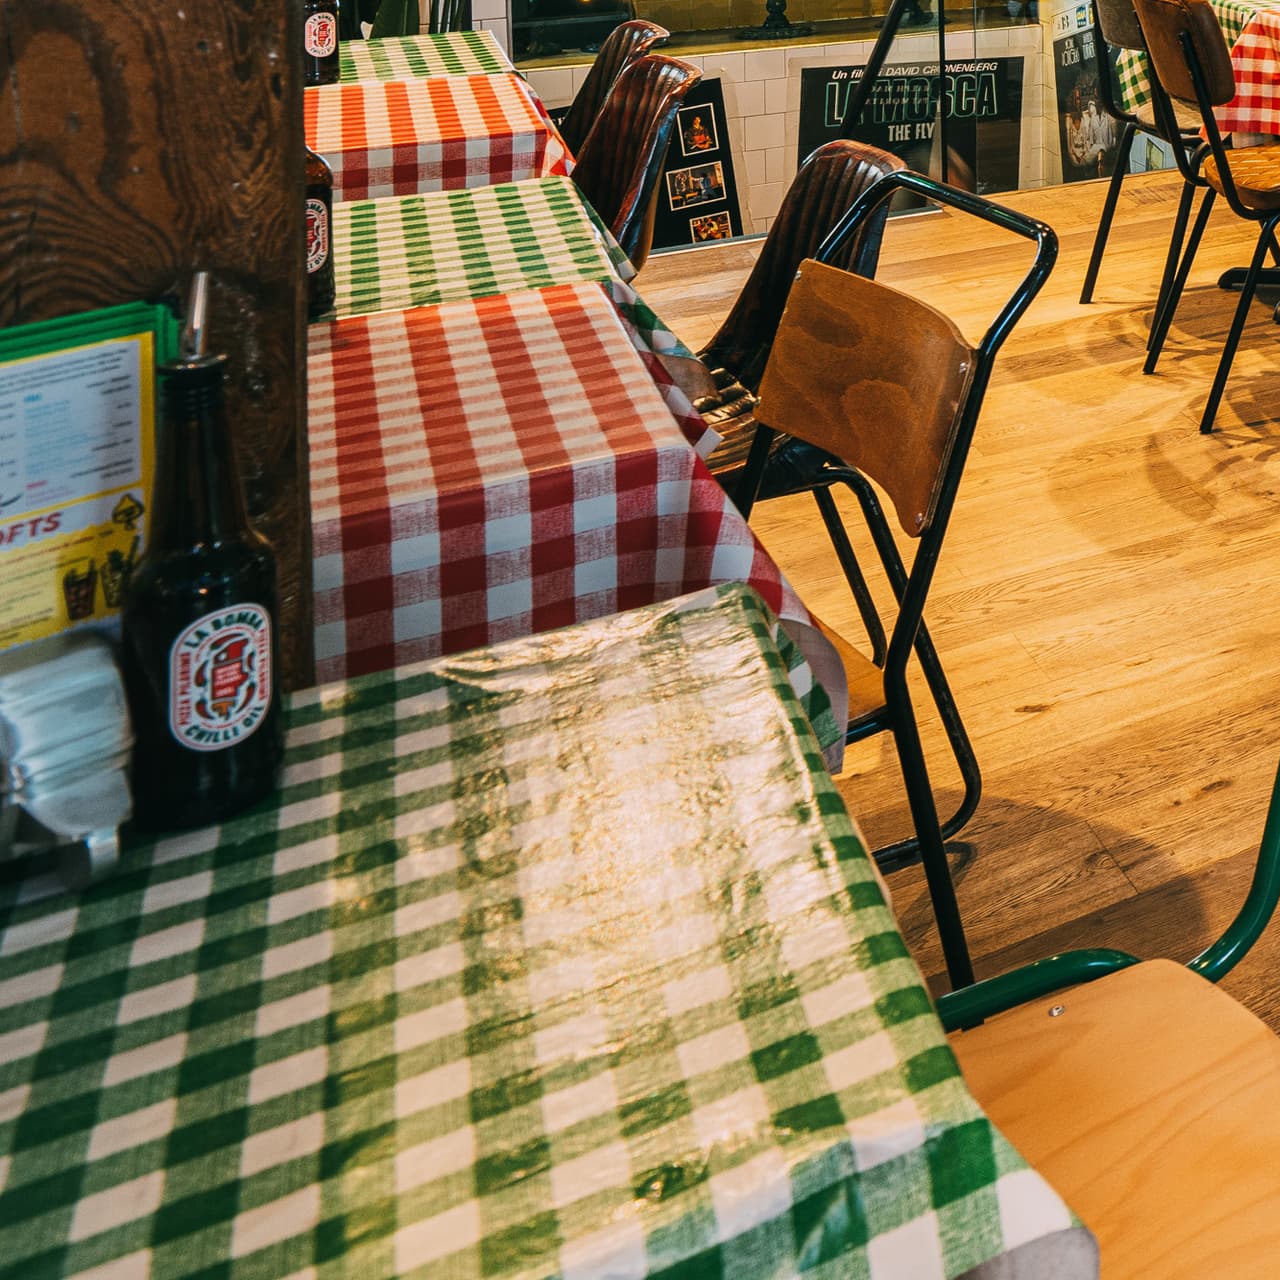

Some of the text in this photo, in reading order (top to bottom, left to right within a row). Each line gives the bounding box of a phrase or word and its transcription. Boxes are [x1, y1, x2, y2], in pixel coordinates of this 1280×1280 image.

[832, 70, 847, 80] Un
[885, 66, 921, 77] DAVID
[872, 73, 998, 125] MOSCA
[888, 122, 935, 142] THE FLY
[185, 629, 208, 648] LA
[184, 705, 264, 744] CHILLI OIL
